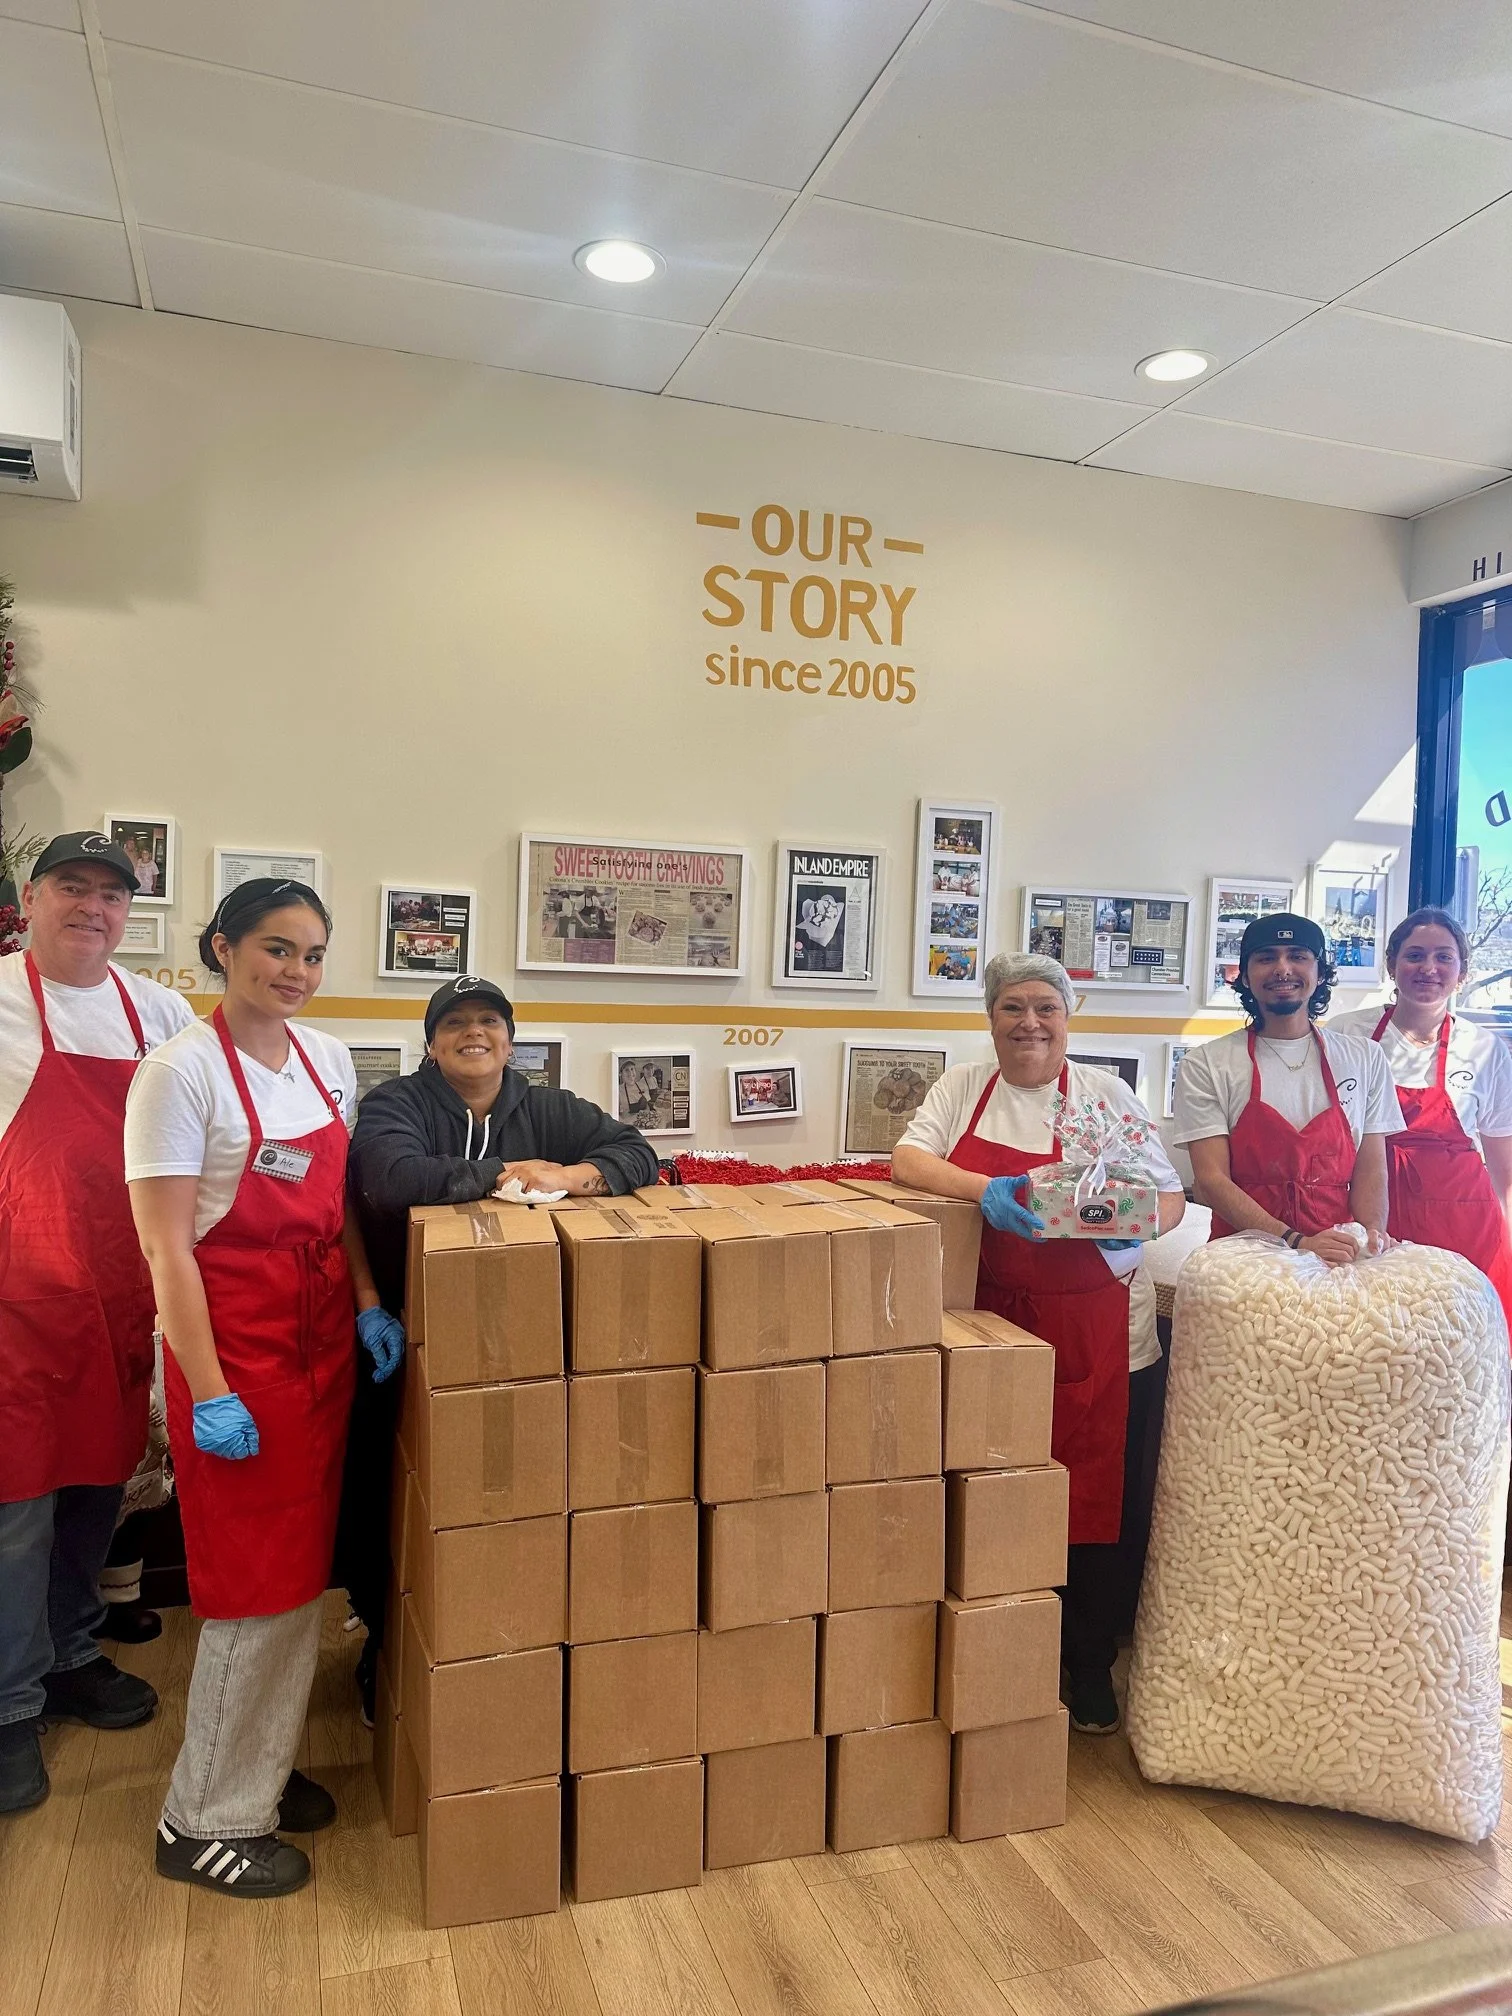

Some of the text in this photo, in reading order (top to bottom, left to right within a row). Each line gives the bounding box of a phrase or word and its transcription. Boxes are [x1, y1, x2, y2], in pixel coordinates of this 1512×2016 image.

[752, 504, 873, 568] OUR
[702, 564, 917, 647] STORY
[705, 645, 916, 704] since 2005
[592, 856, 688, 871] Satisfying one's
[656, 851, 724, 886] CRAVINGS
[794, 856, 869, 877] INLAND EMPIRE
[723, 1028, 784, 1046] 2007
[1088, 1209, 1103, 1217] SPI
